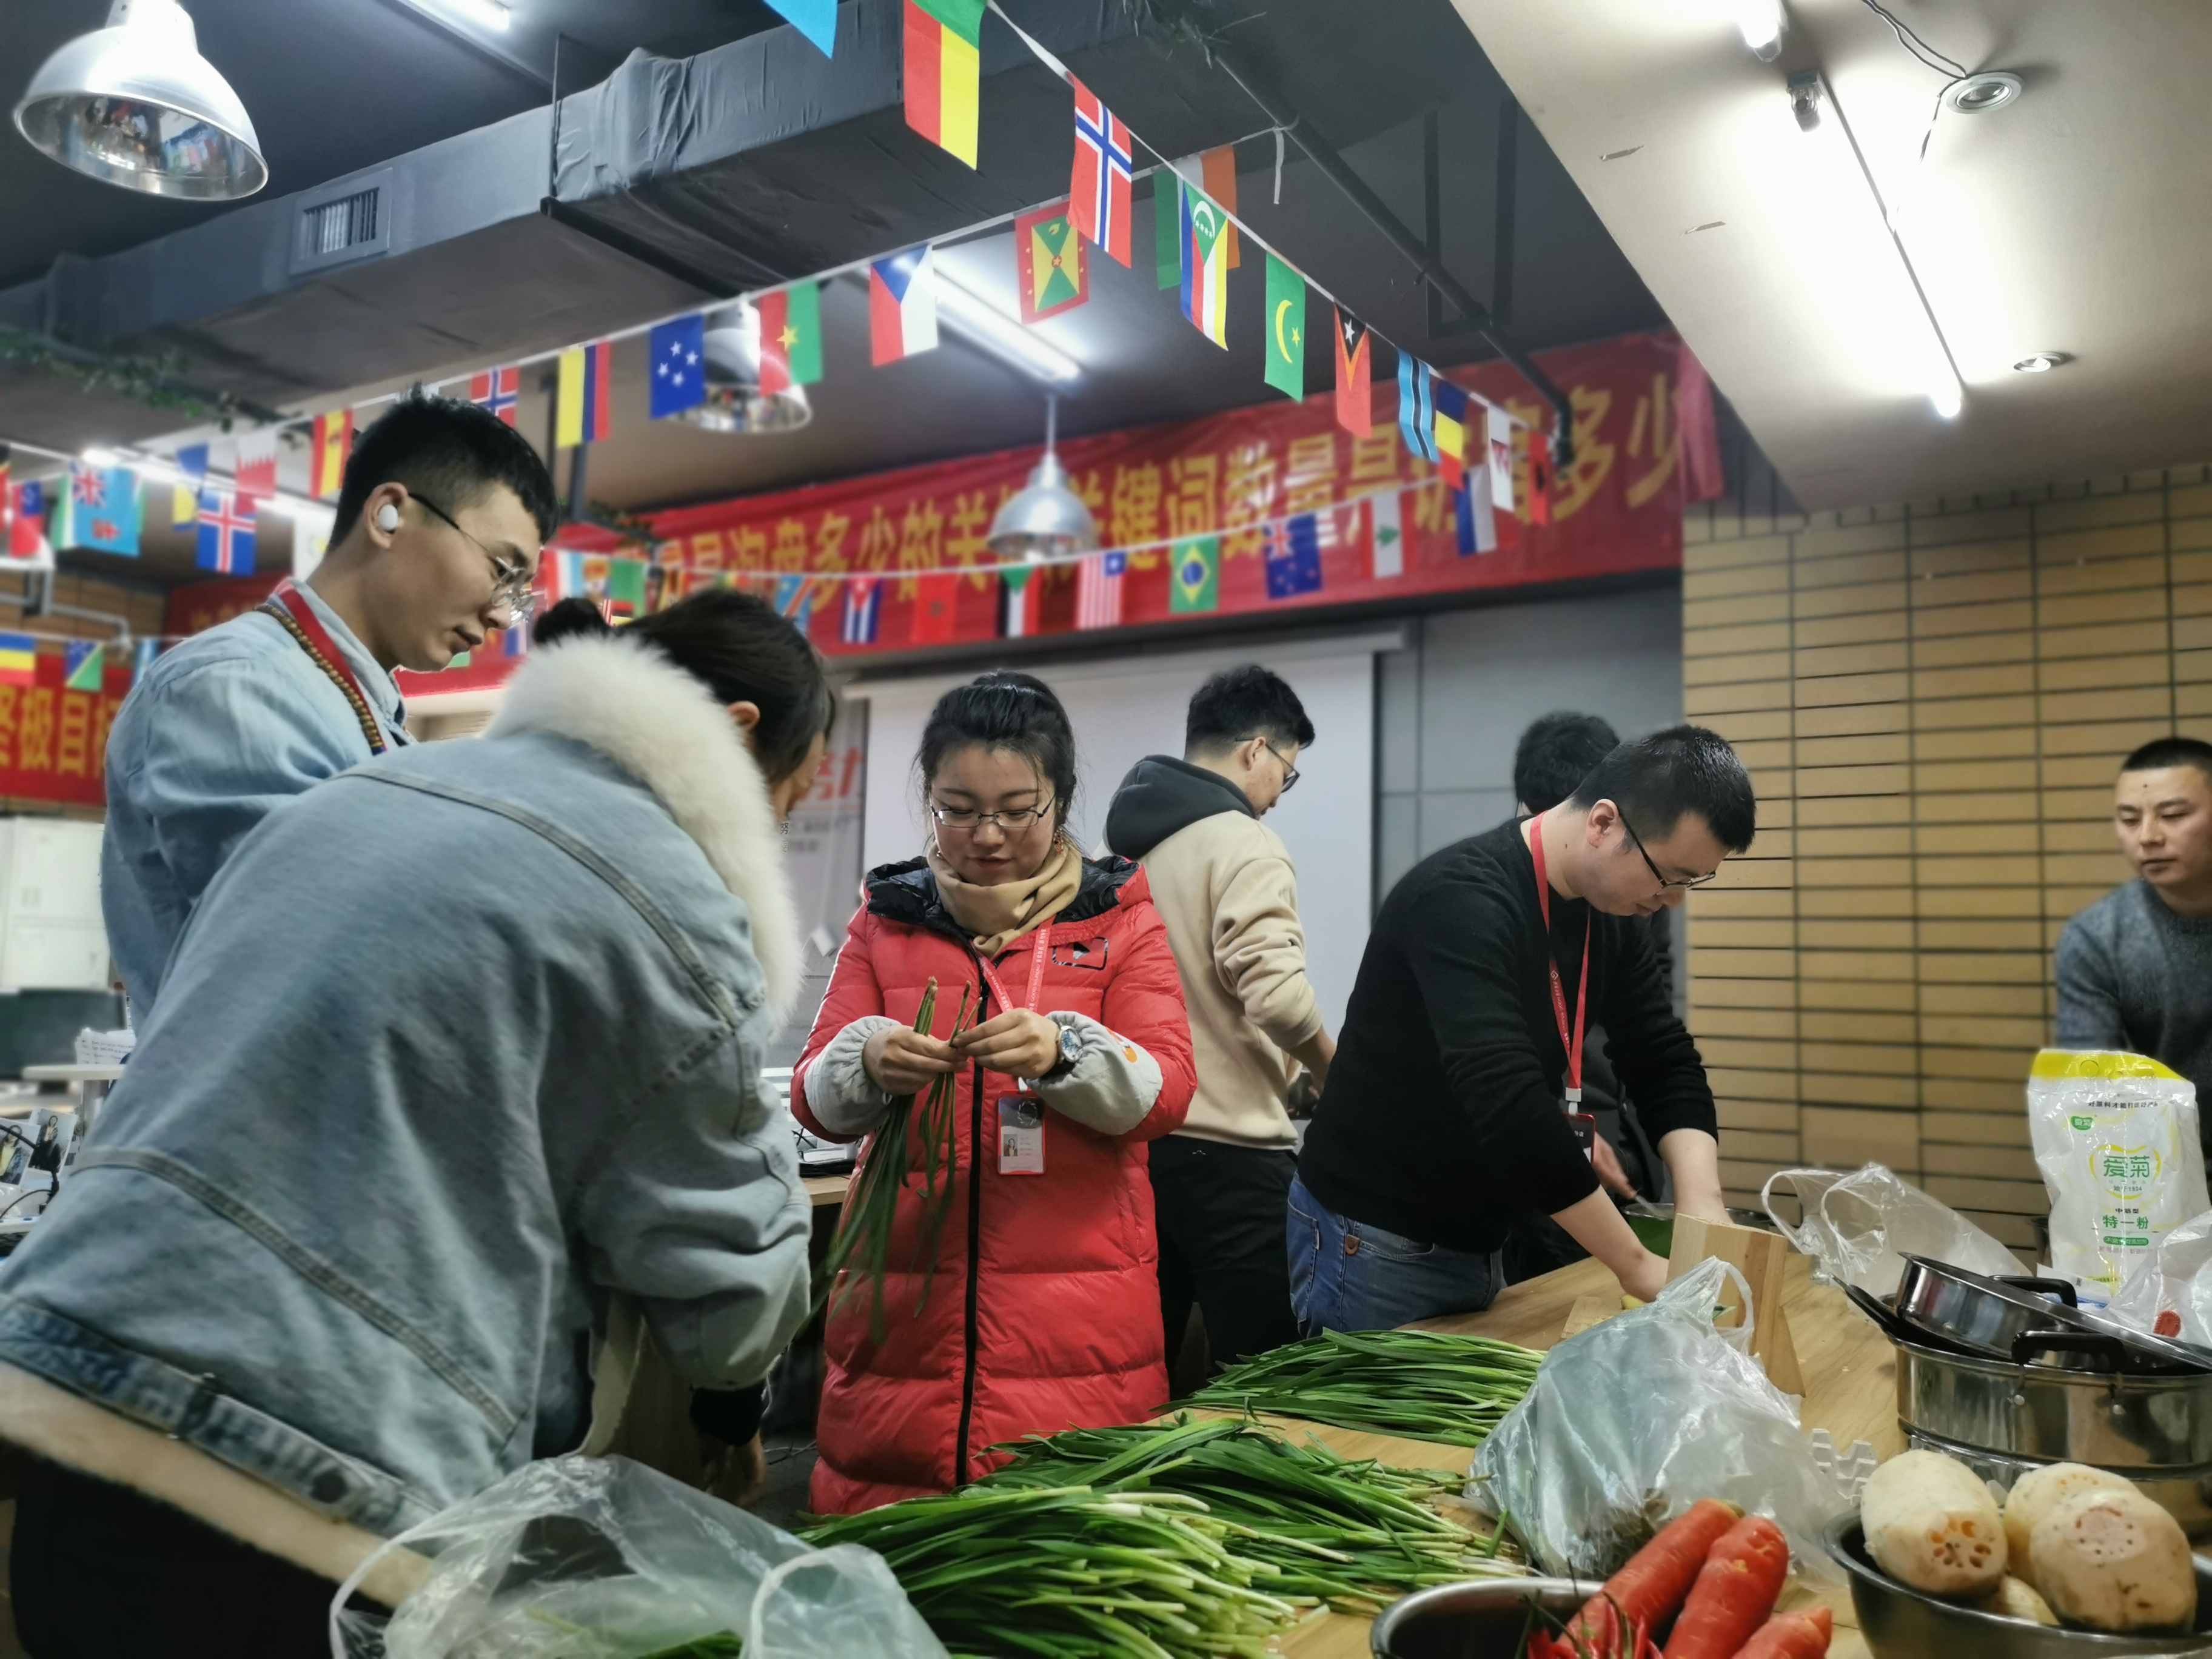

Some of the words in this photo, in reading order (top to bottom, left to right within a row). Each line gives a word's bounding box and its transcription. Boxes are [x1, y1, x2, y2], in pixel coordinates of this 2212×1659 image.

[2103, 1155, 2150, 1178] 爱菊
[2102, 1215, 2149, 1230] 特一粉
